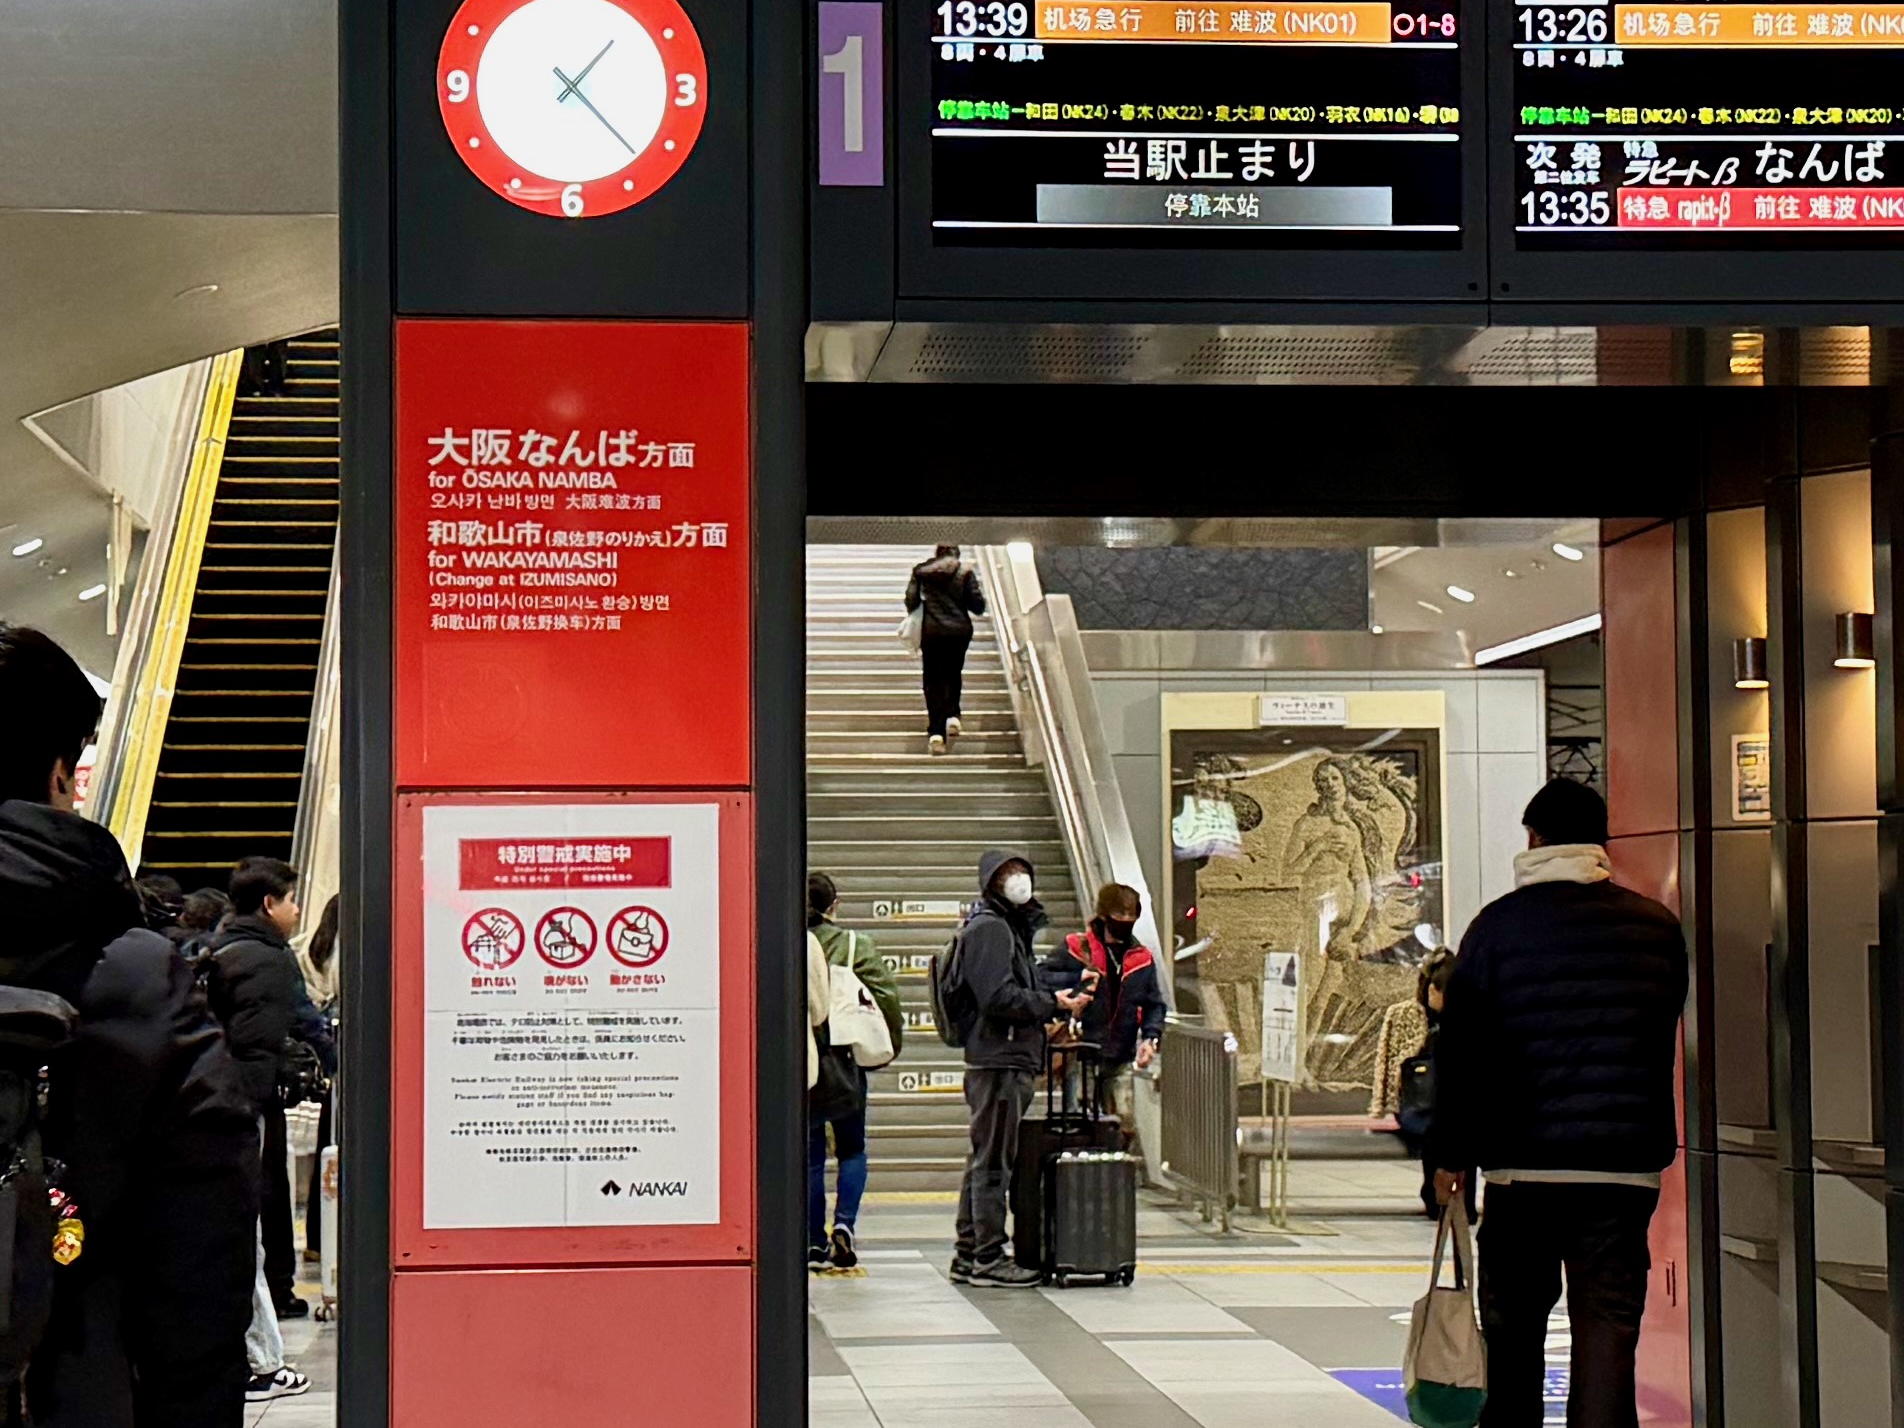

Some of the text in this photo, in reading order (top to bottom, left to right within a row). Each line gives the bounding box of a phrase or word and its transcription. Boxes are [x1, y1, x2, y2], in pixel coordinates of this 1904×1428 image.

[937, 0, 1028, 37] 13:39
[1043, 7, 1143, 32] 机场急行
[1519, 8, 1607, 42] 13:26
[1623, 12, 1721, 37] 机场急行
[446, 70, 470, 103] 9
[674, 73, 696, 107] 3
[823, 36, 863, 152] 1
[1103, 138, 1315, 181] 当駅止まり
[1755, 141, 1886, 183] なんば
[560, 183, 584, 217] 6
[1164, 193, 1260, 218] 停靠本站
[1521, 190, 1610, 225] 13:35
[1623, 195, 1671, 220] 特急
[428, 471, 455, 489] for
[539, 471, 617, 489] NAMBA
[430, 494, 481, 510] 오사카
[488, 494, 521, 510] 난바
[524, 494, 555, 510] 방면
[428, 551, 618, 569] for WAKAYAMASHI
[429, 572, 617, 589] (Change at IZUMISANO)
[498, 844, 632, 864] 特別警戒実施中
[629, 1182, 687, 1196] NANKAI
